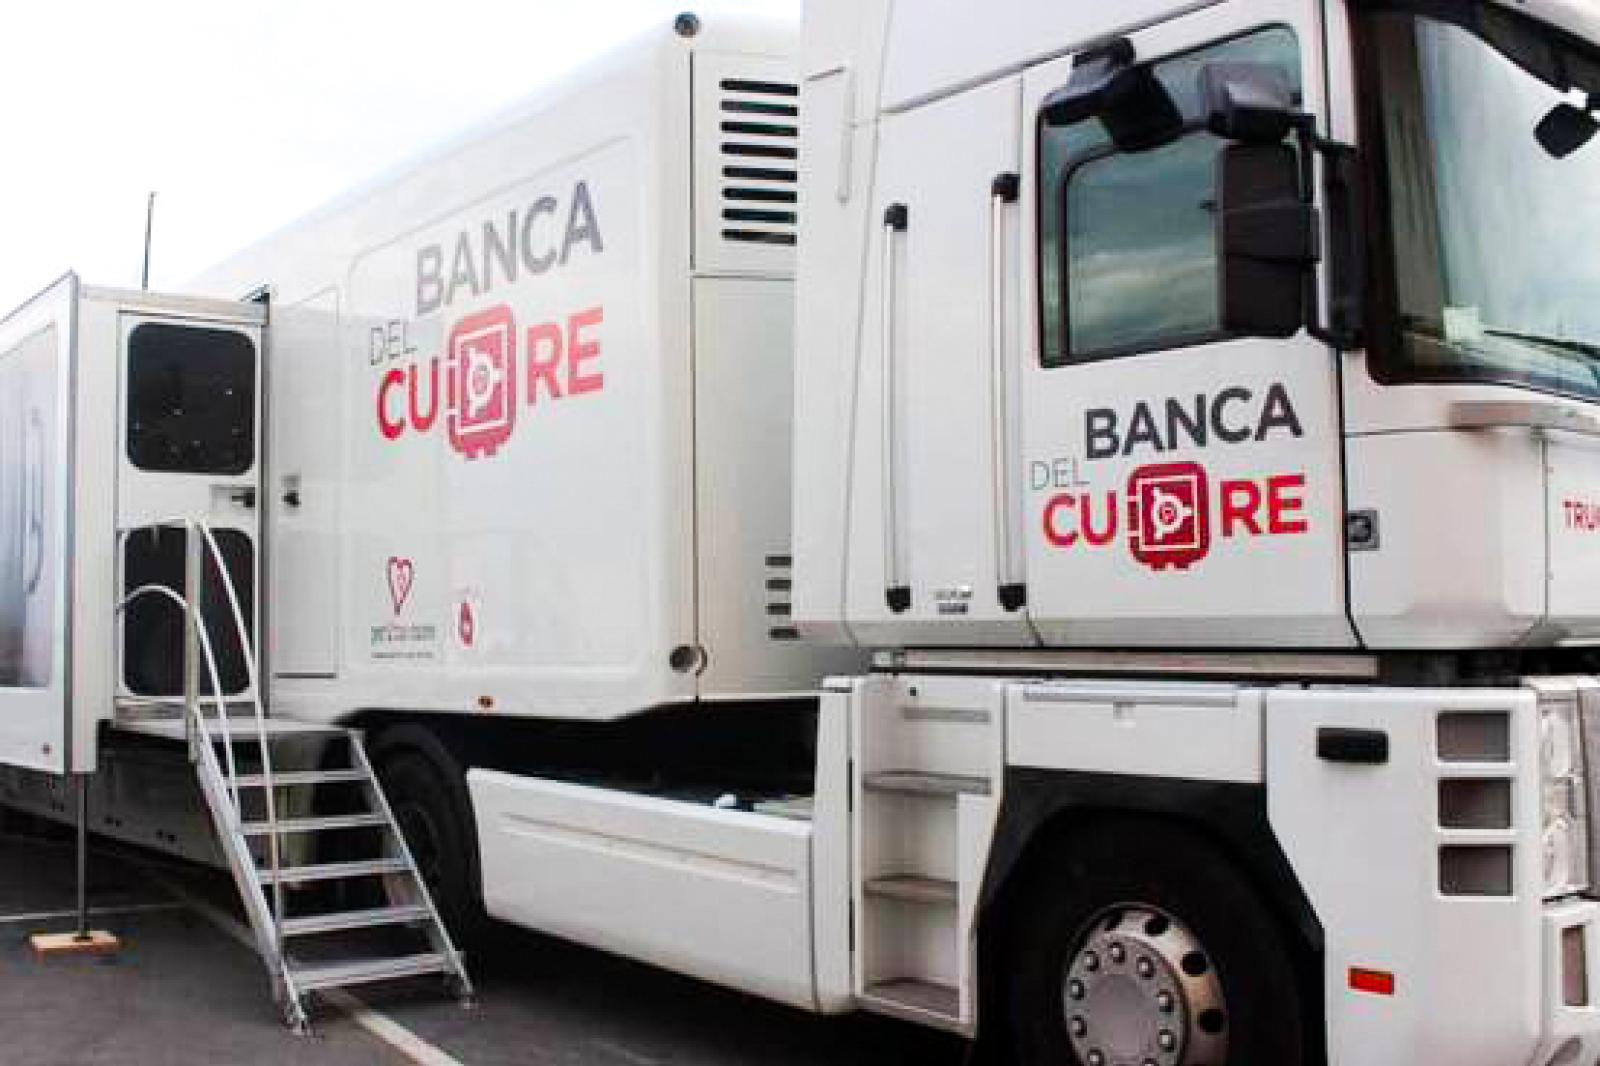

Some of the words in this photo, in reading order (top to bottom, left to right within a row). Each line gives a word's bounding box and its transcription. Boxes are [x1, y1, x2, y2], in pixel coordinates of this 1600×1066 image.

[416, 180, 603, 315] BANCA
[370, 319, 418, 366] DEL
[1085, 382, 1302, 460] BANCA
[1030, 457, 1090, 490] DEL
